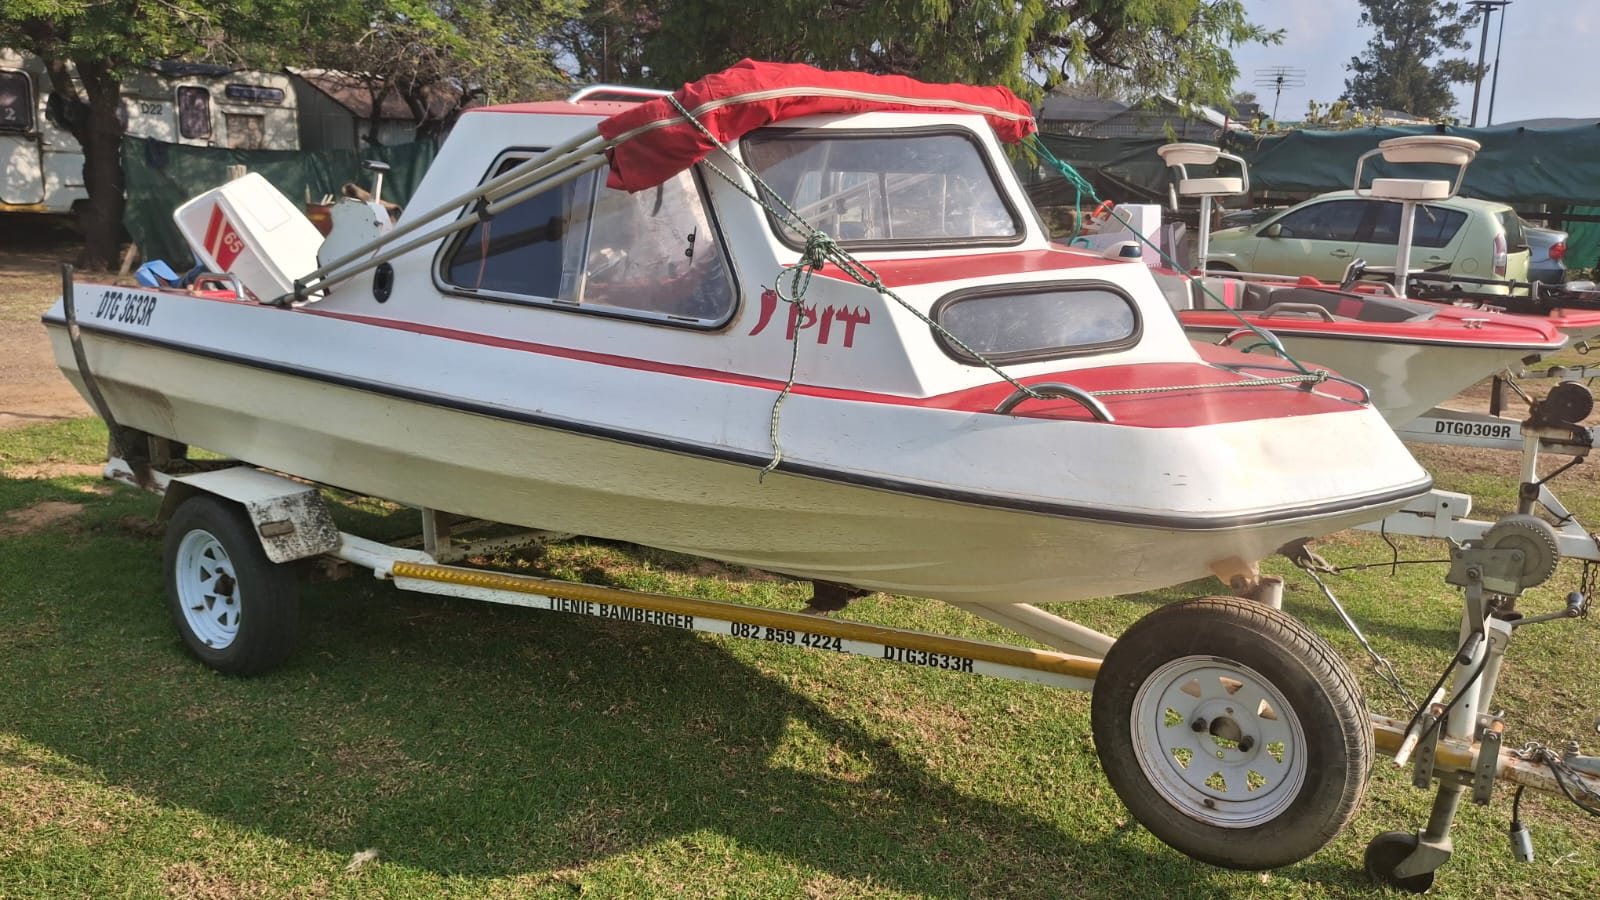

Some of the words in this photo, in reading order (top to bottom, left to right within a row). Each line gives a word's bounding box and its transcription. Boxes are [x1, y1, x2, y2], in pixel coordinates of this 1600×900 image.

[141, 103, 163, 116] D22
[224, 232, 244, 254] 65
[96, 290, 123, 321] DTG
[118, 293, 157, 327] 3633R
[1435, 420, 1512, 438] DTG0309R
[547, 596, 595, 616] TIENIE
[599, 603, 694, 630] BAMBERGER
[730, 622, 760, 640] 082
[765, 627, 796, 645] 859
[801, 632, 843, 652] 4224
[884, 645, 974, 673] DTG3633R
